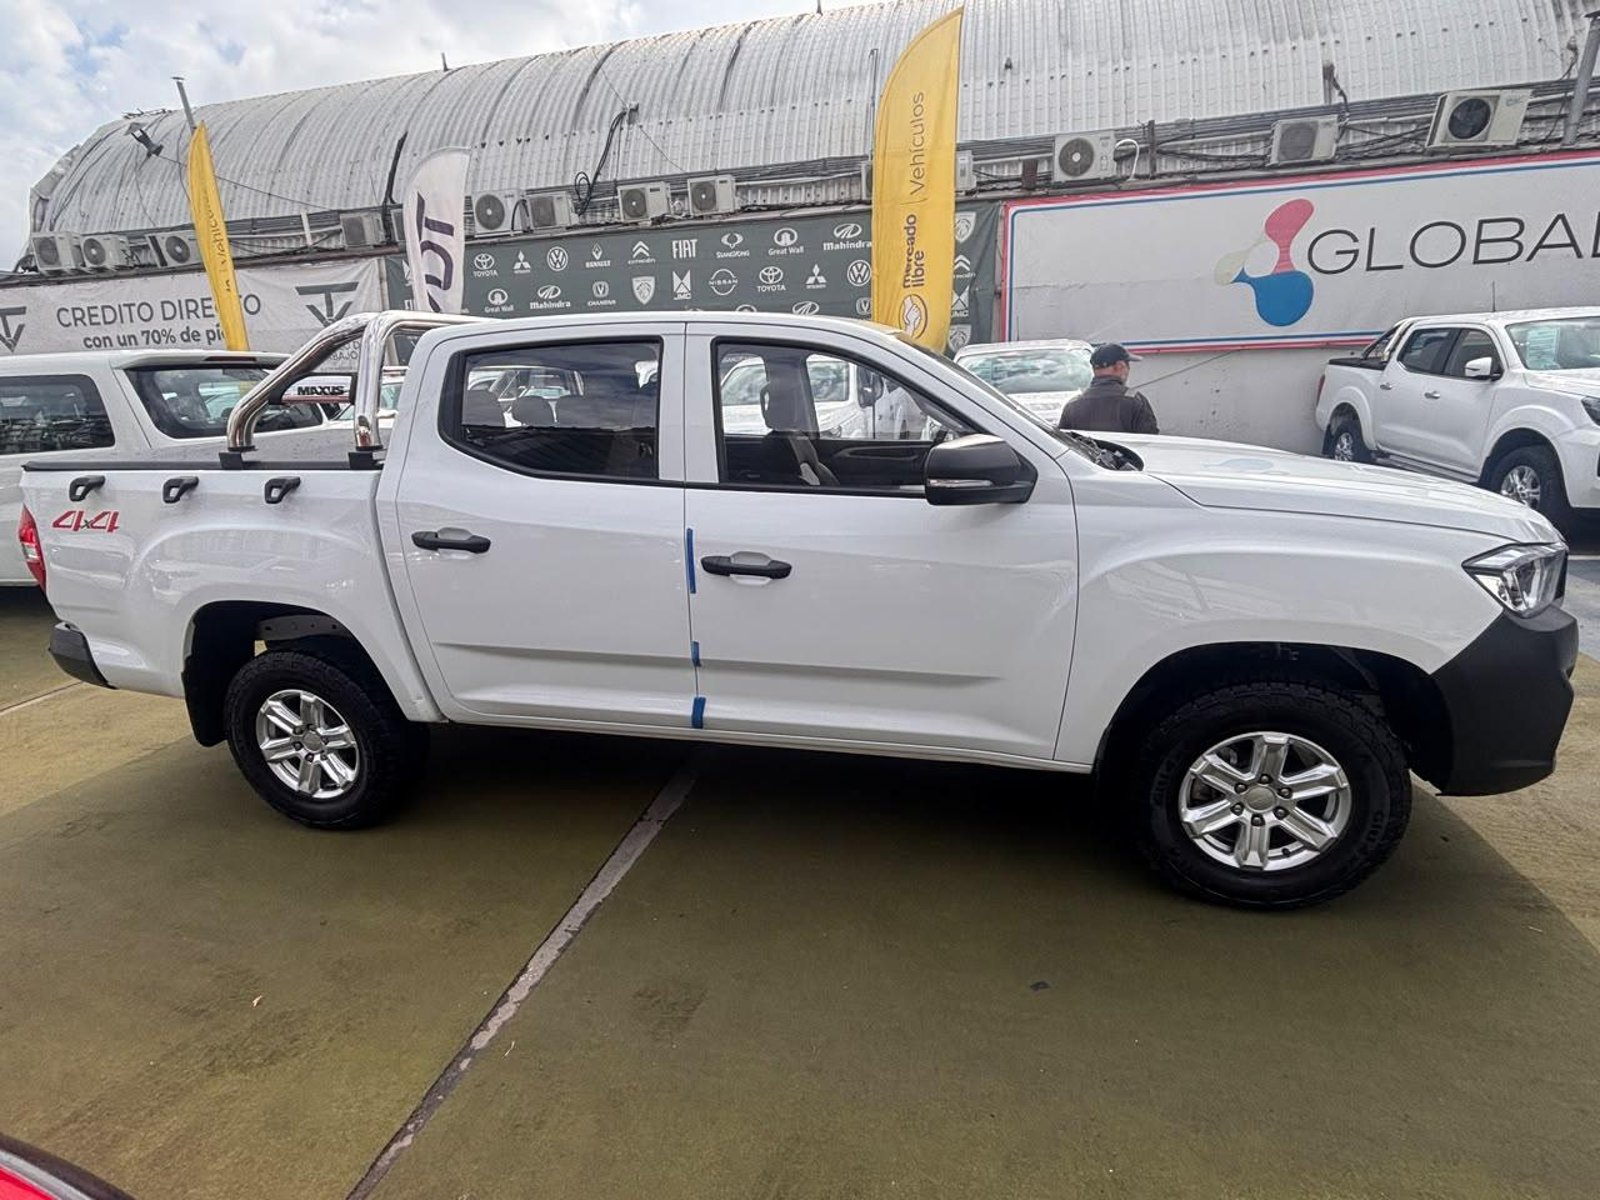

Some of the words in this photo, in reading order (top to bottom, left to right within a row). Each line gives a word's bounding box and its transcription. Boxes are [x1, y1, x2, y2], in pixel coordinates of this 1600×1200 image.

[672, 239, 698, 260] FIAT
[822, 240, 873, 252] Mahindra
[1306, 210, 1600, 275] GLOBA
[767, 248, 788, 256] Great
[788, 246, 804, 255] Wall
[902, 213, 918, 290] mercado
[473, 269, 499, 278] TOYOTA
[910, 250, 926, 288] libre
[756, 284, 787, 293] TOYOTA
[56, 301, 154, 329] CREDITO
[160, 293, 262, 322] DIREO
[484, 306, 501, 314] Great
[501, 304, 515, 313] Wall
[529, 300, 571, 310] Mahindra
[83, 335, 113, 349] con
[116, 333, 139, 347] un
[140, 328, 177, 346] 70%
[180, 325, 201, 343] de
[205, 323, 225, 345] pi
[297, 385, 345, 396] MAXUS
[52, 510, 120, 533] 4x4
